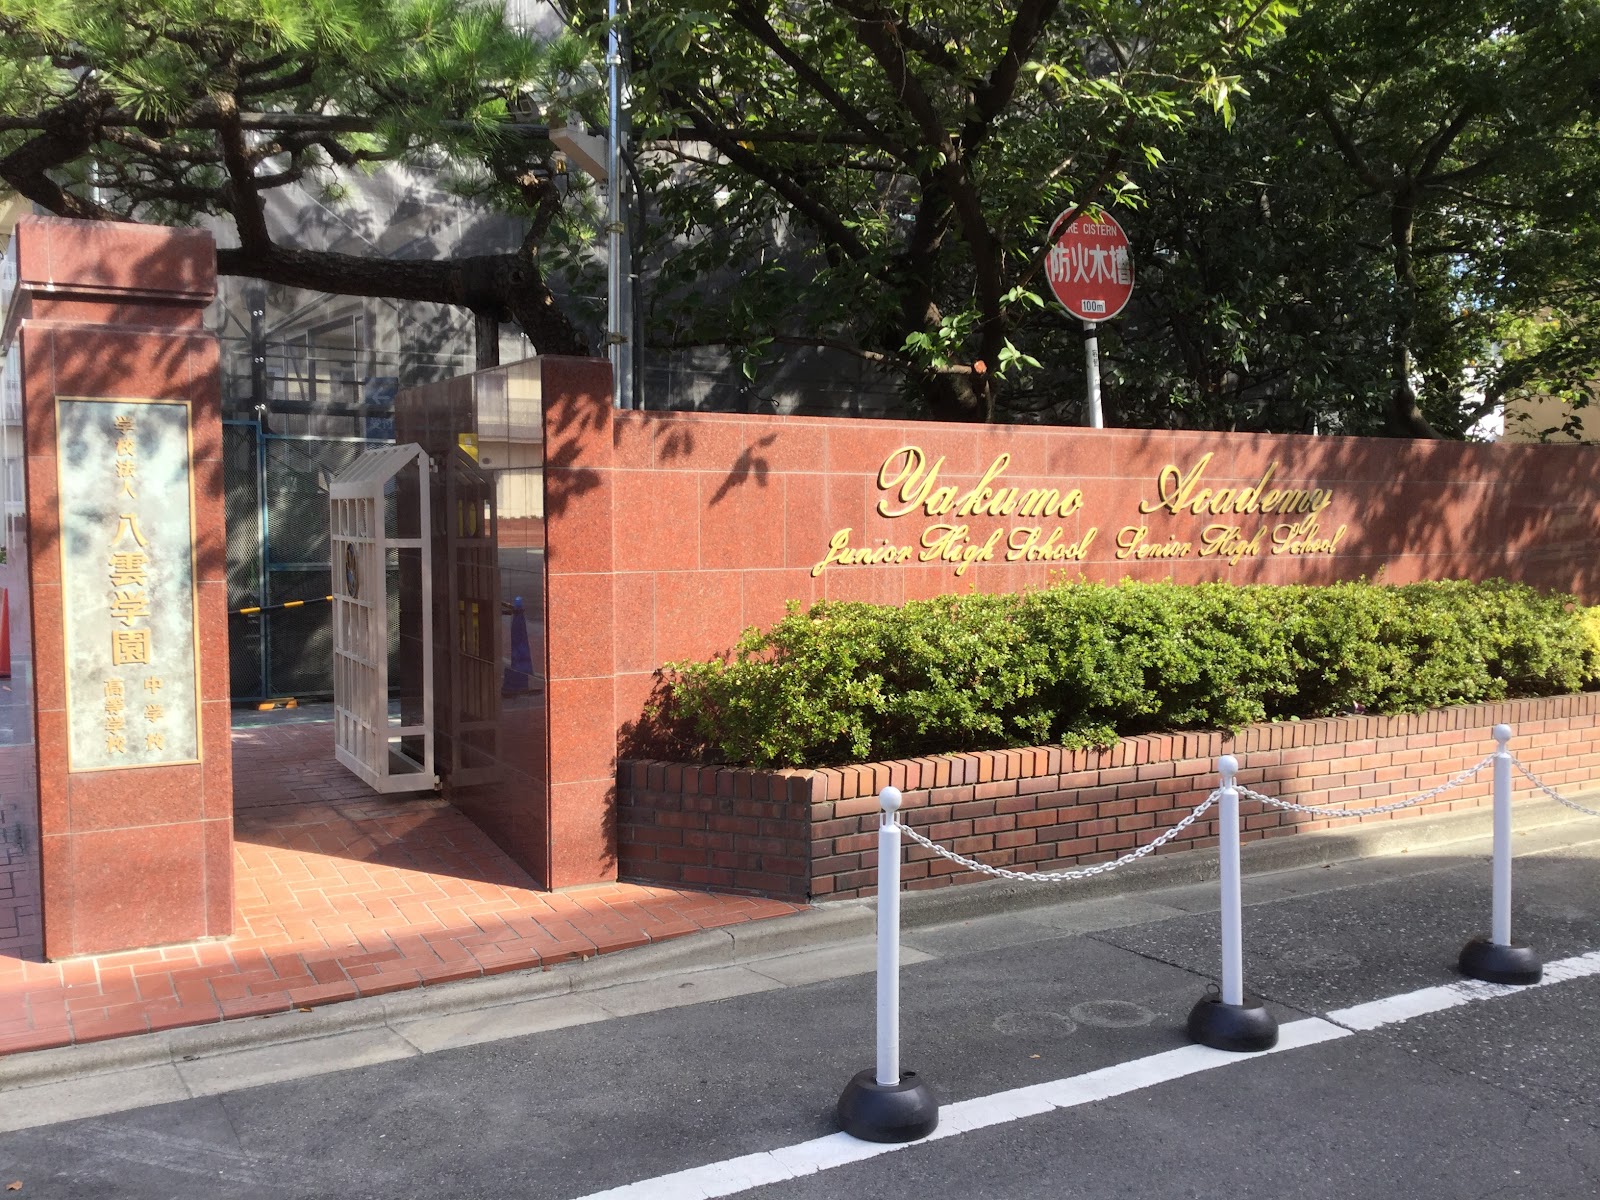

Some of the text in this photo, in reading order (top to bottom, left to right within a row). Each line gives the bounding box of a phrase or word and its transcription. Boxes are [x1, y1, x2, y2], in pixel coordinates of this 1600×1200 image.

[1083, 223, 1117, 236] CISTERN
[876, 446, 1333, 535] Yakumo Academy
[811, 523, 1347, 577] Junior High School Senior High School
[104, 678, 126, 754] 高等学校
[144, 676, 165, 751] 中学校
